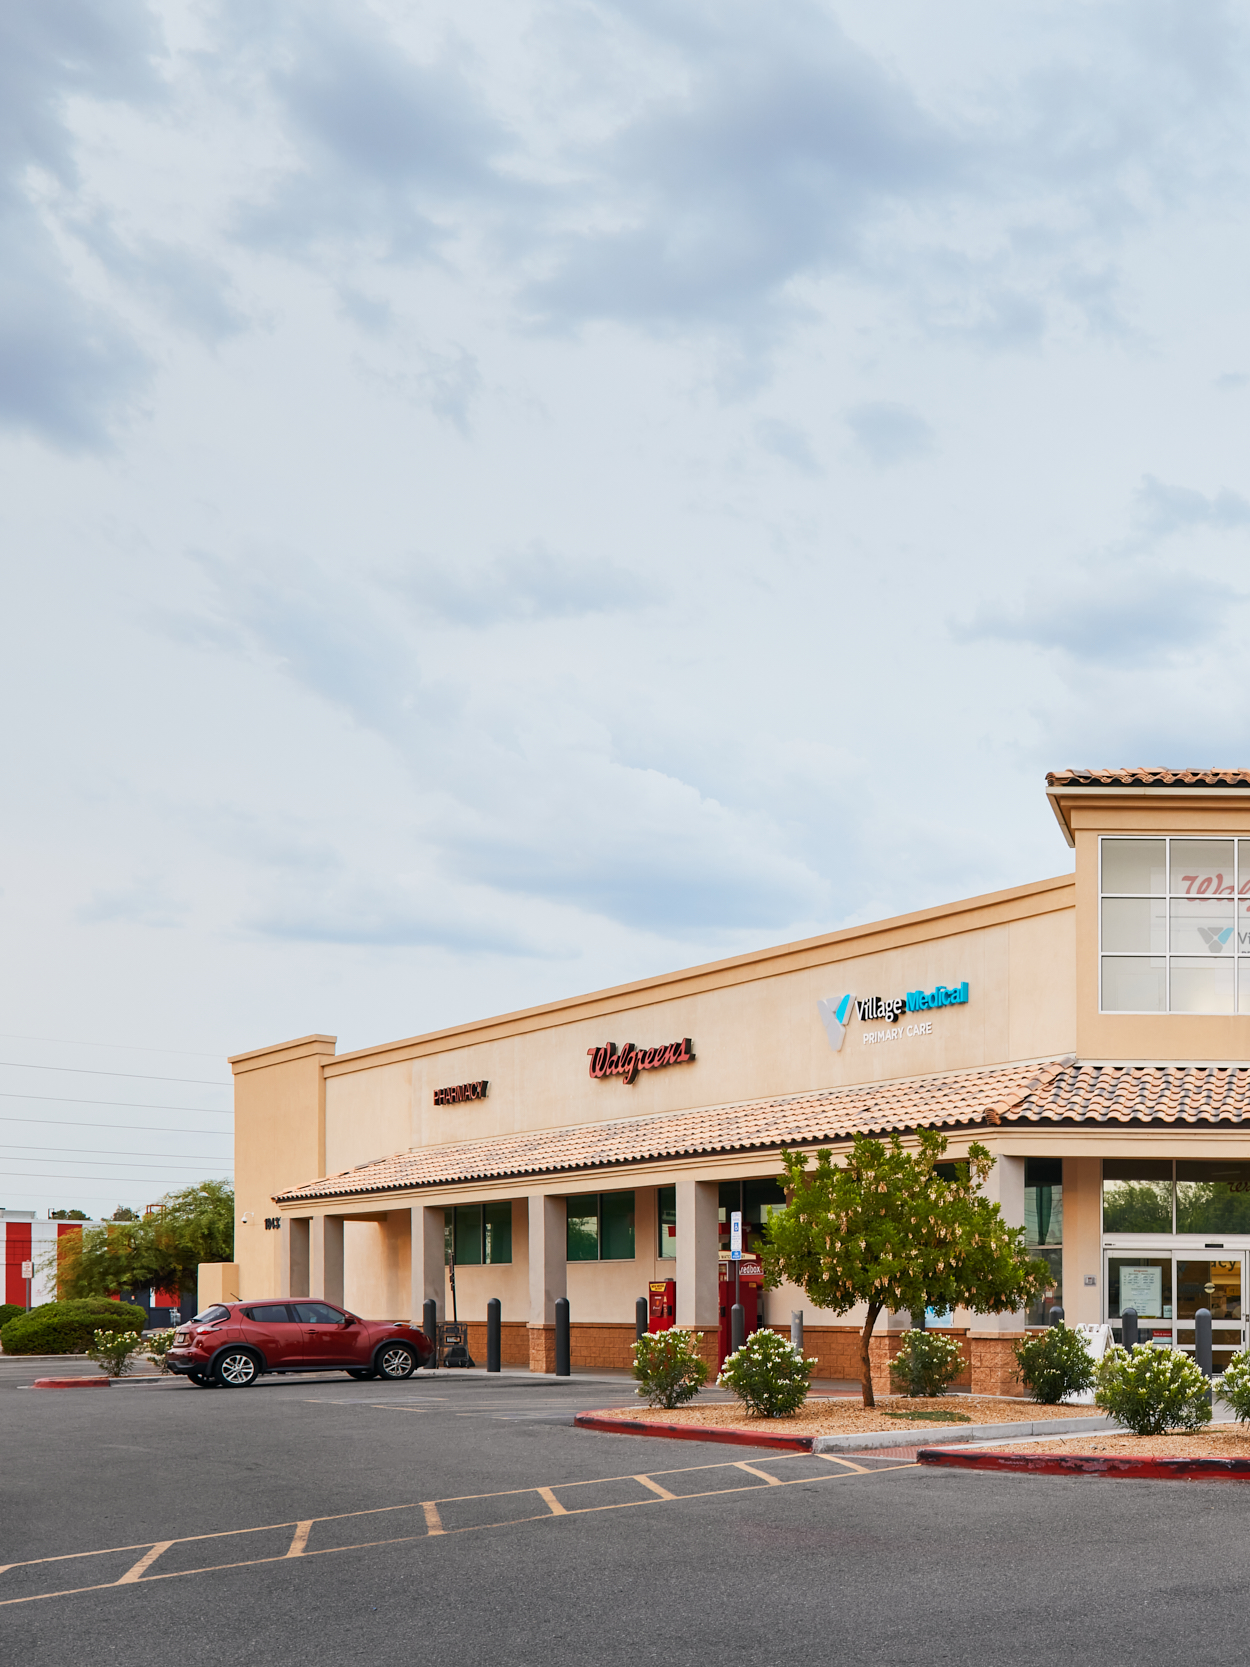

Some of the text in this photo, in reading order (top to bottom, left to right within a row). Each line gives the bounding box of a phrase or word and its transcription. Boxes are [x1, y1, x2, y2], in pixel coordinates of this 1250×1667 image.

[855, 981, 969, 1023] Village Medical
[863, 1022, 932, 1045] PRIMARY CARE
[587, 1038, 695, 1085] Walgreens
[433, 1080, 489, 1106] PHARMACY
[740, 1264, 761, 1274] redbox
